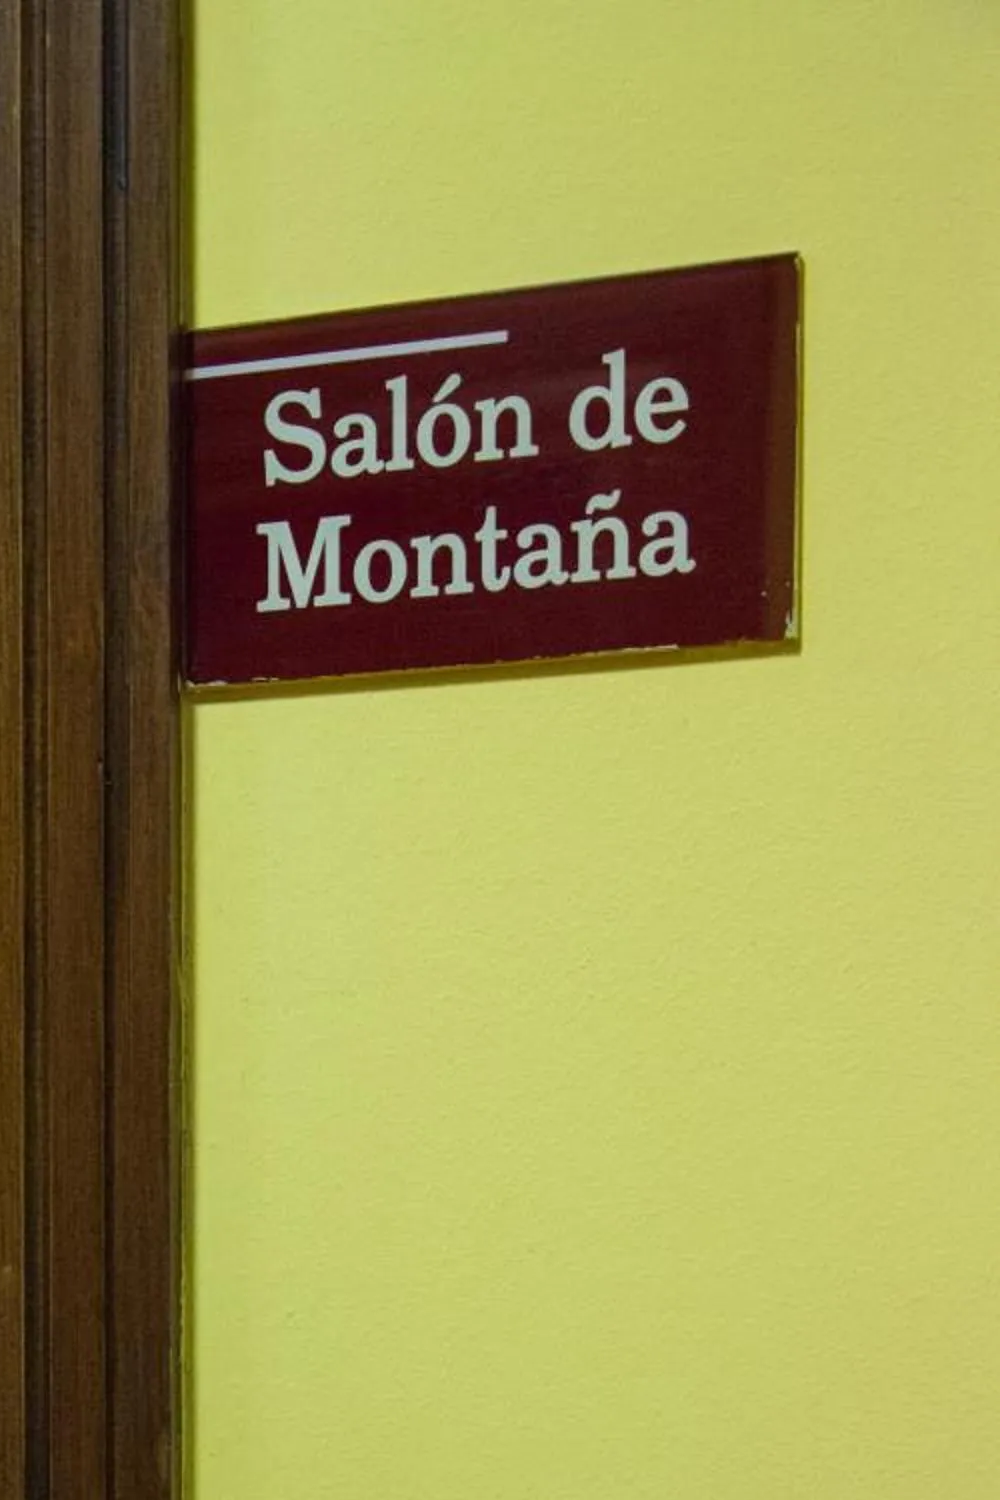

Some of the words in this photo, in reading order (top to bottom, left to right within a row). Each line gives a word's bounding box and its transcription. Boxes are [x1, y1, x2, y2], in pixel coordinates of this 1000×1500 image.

[264, 374, 539, 487] Salón
[569, 349, 690, 451] de
[256, 489, 696, 612] Montaña
